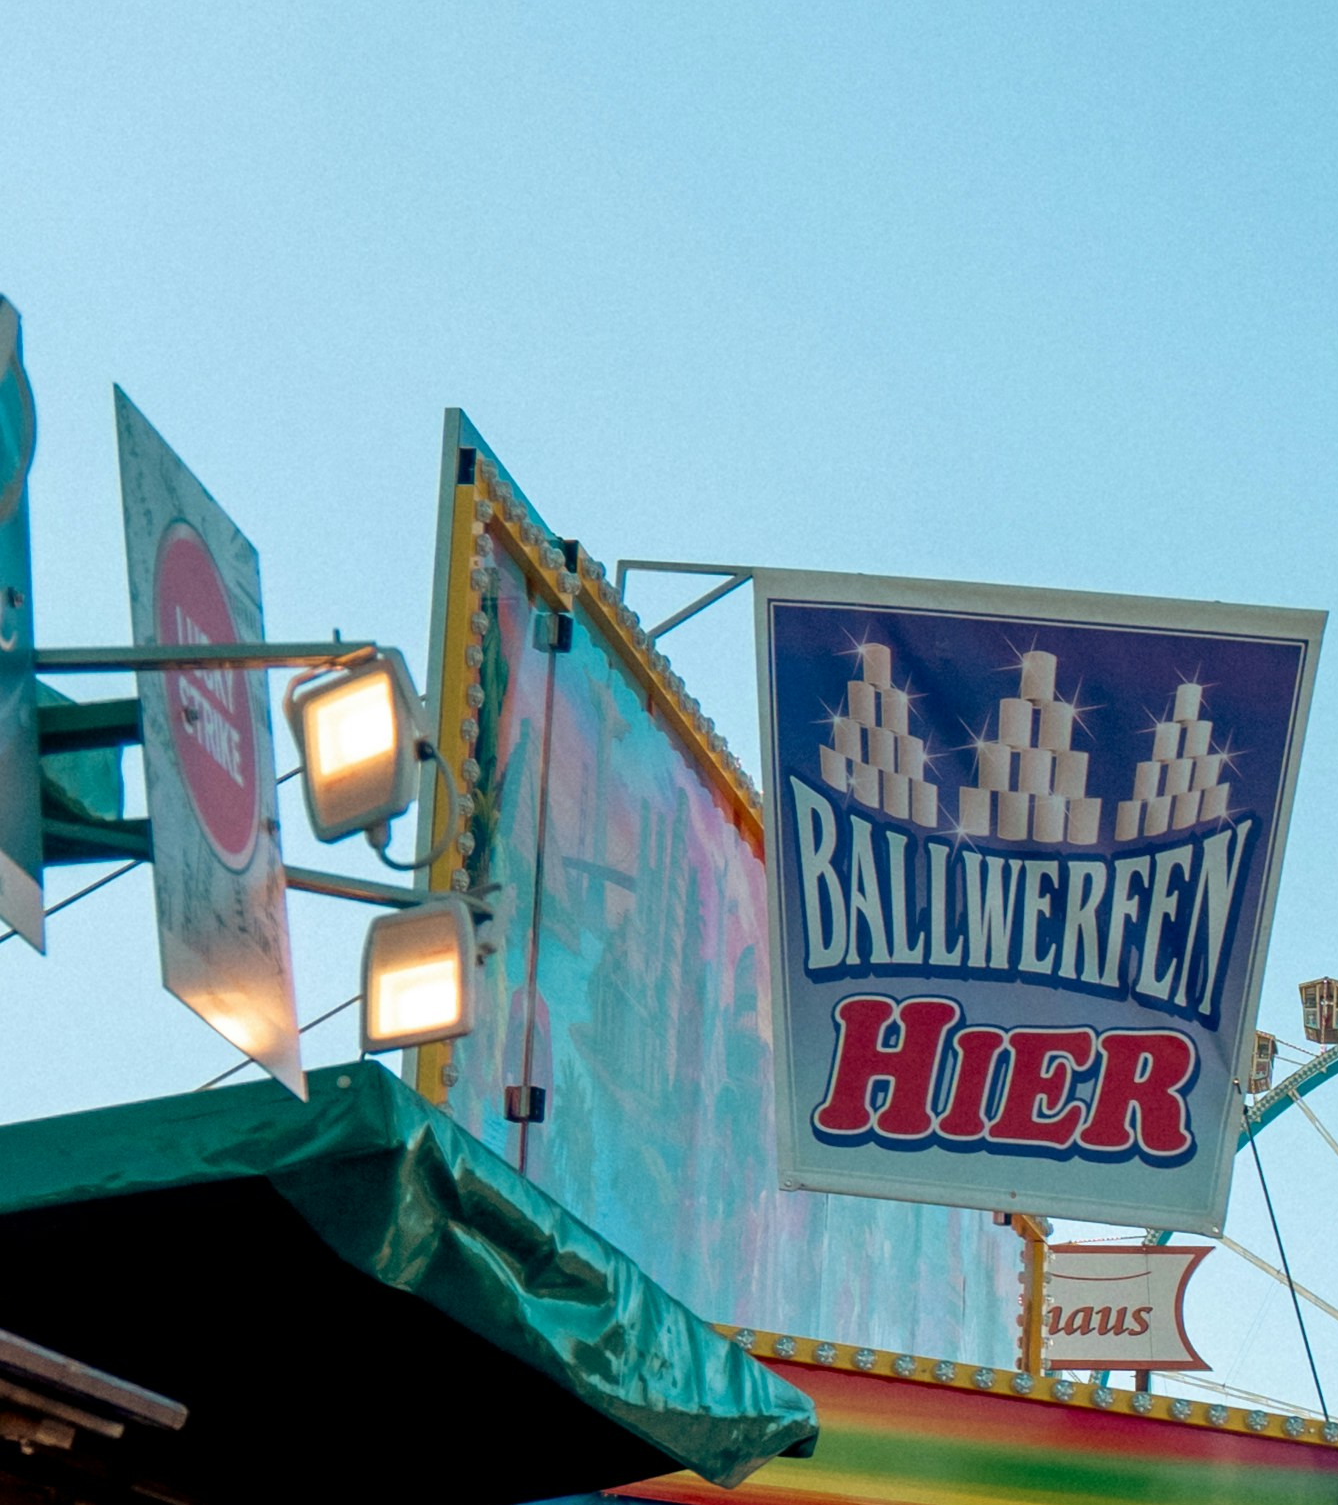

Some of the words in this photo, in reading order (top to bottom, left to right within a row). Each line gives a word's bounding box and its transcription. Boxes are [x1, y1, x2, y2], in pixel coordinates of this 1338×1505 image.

[178, 673, 244, 788] STRIKE
[790, 775, 1255, 1015] BALLWERFEN
[814, 996, 1198, 1157] HIER
